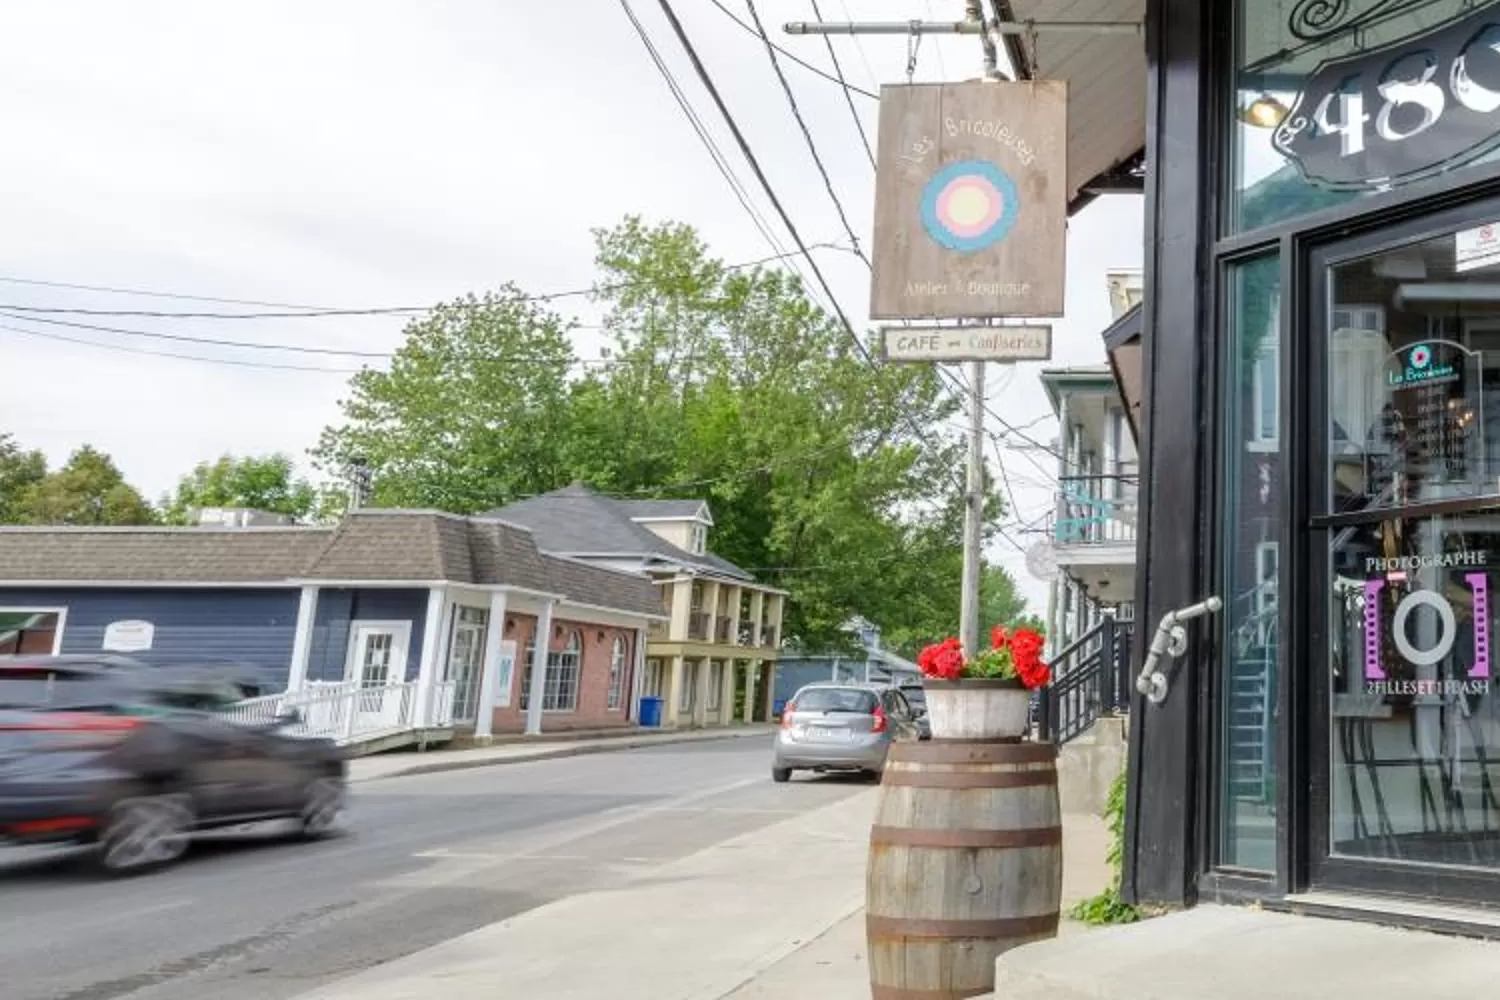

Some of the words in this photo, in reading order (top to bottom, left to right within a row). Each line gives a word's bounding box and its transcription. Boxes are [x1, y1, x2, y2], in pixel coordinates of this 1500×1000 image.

[944, 116, 1036, 167] Bricoleuses
[897, 331, 941, 351] CAFÉ
[969, 333, 1042, 353] Confiseries
[1365, 551, 1488, 573] PHOTOGRAPHE
